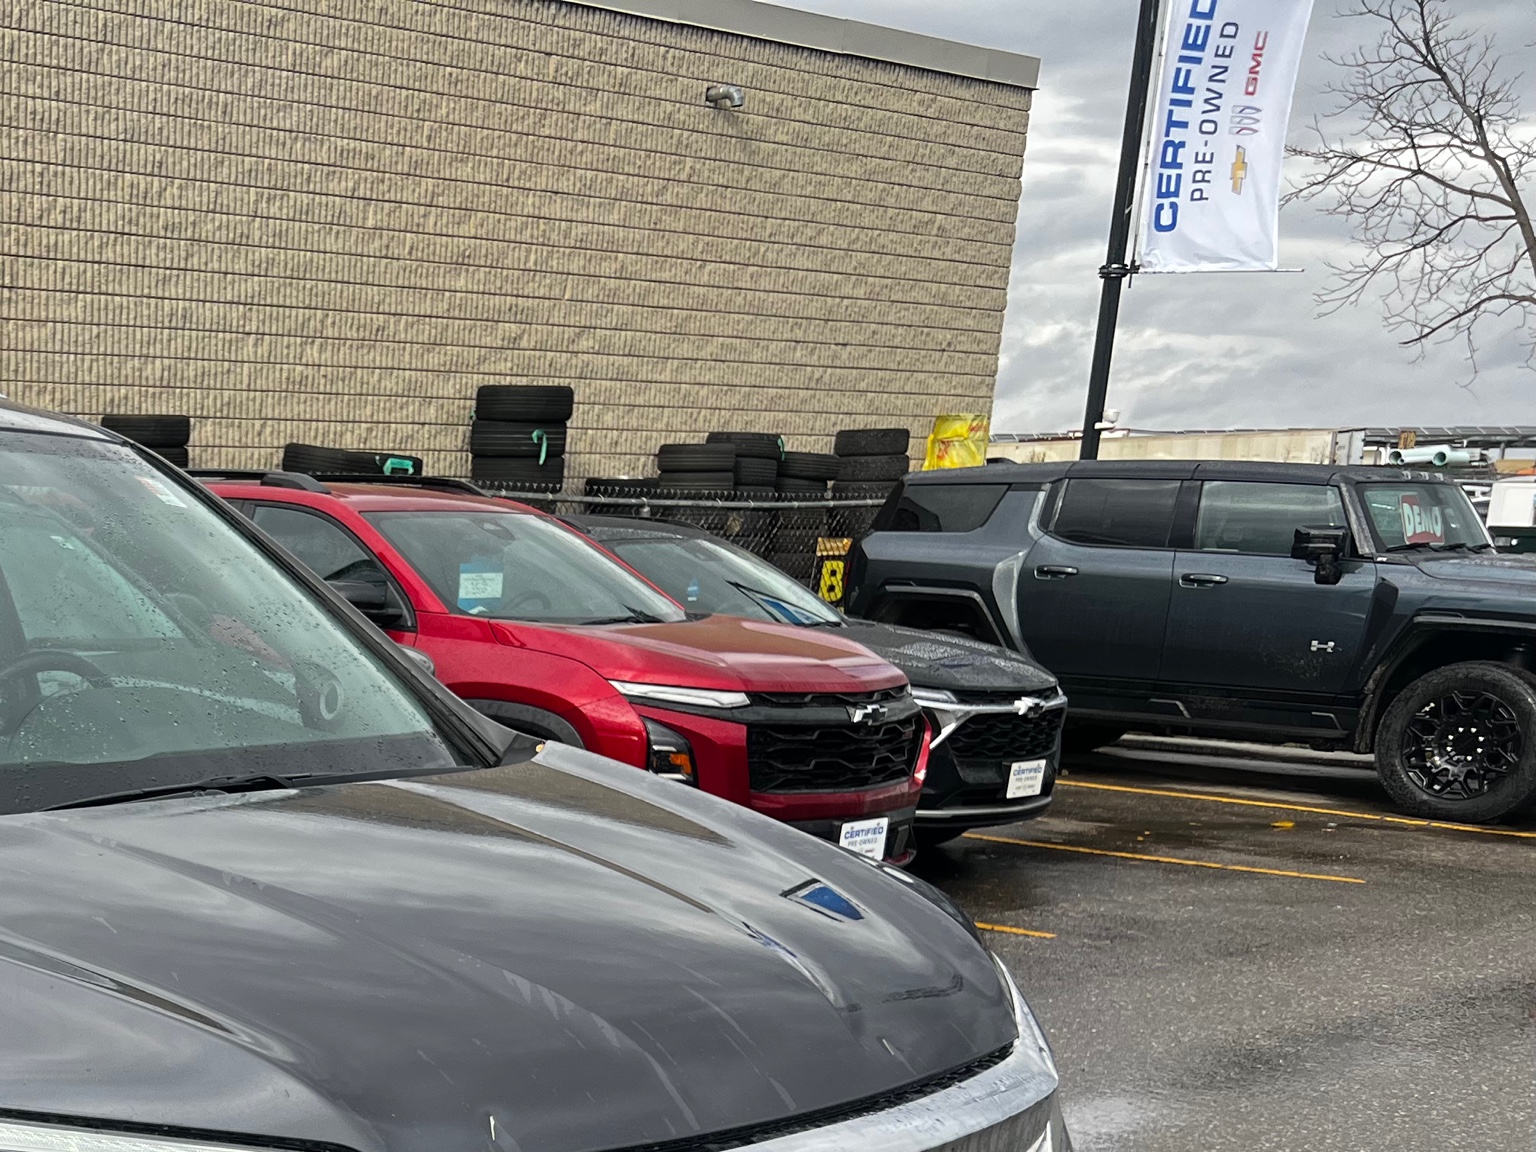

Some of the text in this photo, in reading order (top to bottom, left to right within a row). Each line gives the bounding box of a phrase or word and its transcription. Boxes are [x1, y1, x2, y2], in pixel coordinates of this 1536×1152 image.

[1245, 30, 1268, 96] GMC
[1154, 0, 1218, 233] CERTIFIED
[1190, 21, 1239, 202] PRE-OWNED
[1402, 503, 1442, 538] DEMO
[844, 826, 884, 840] CERTIFIED
